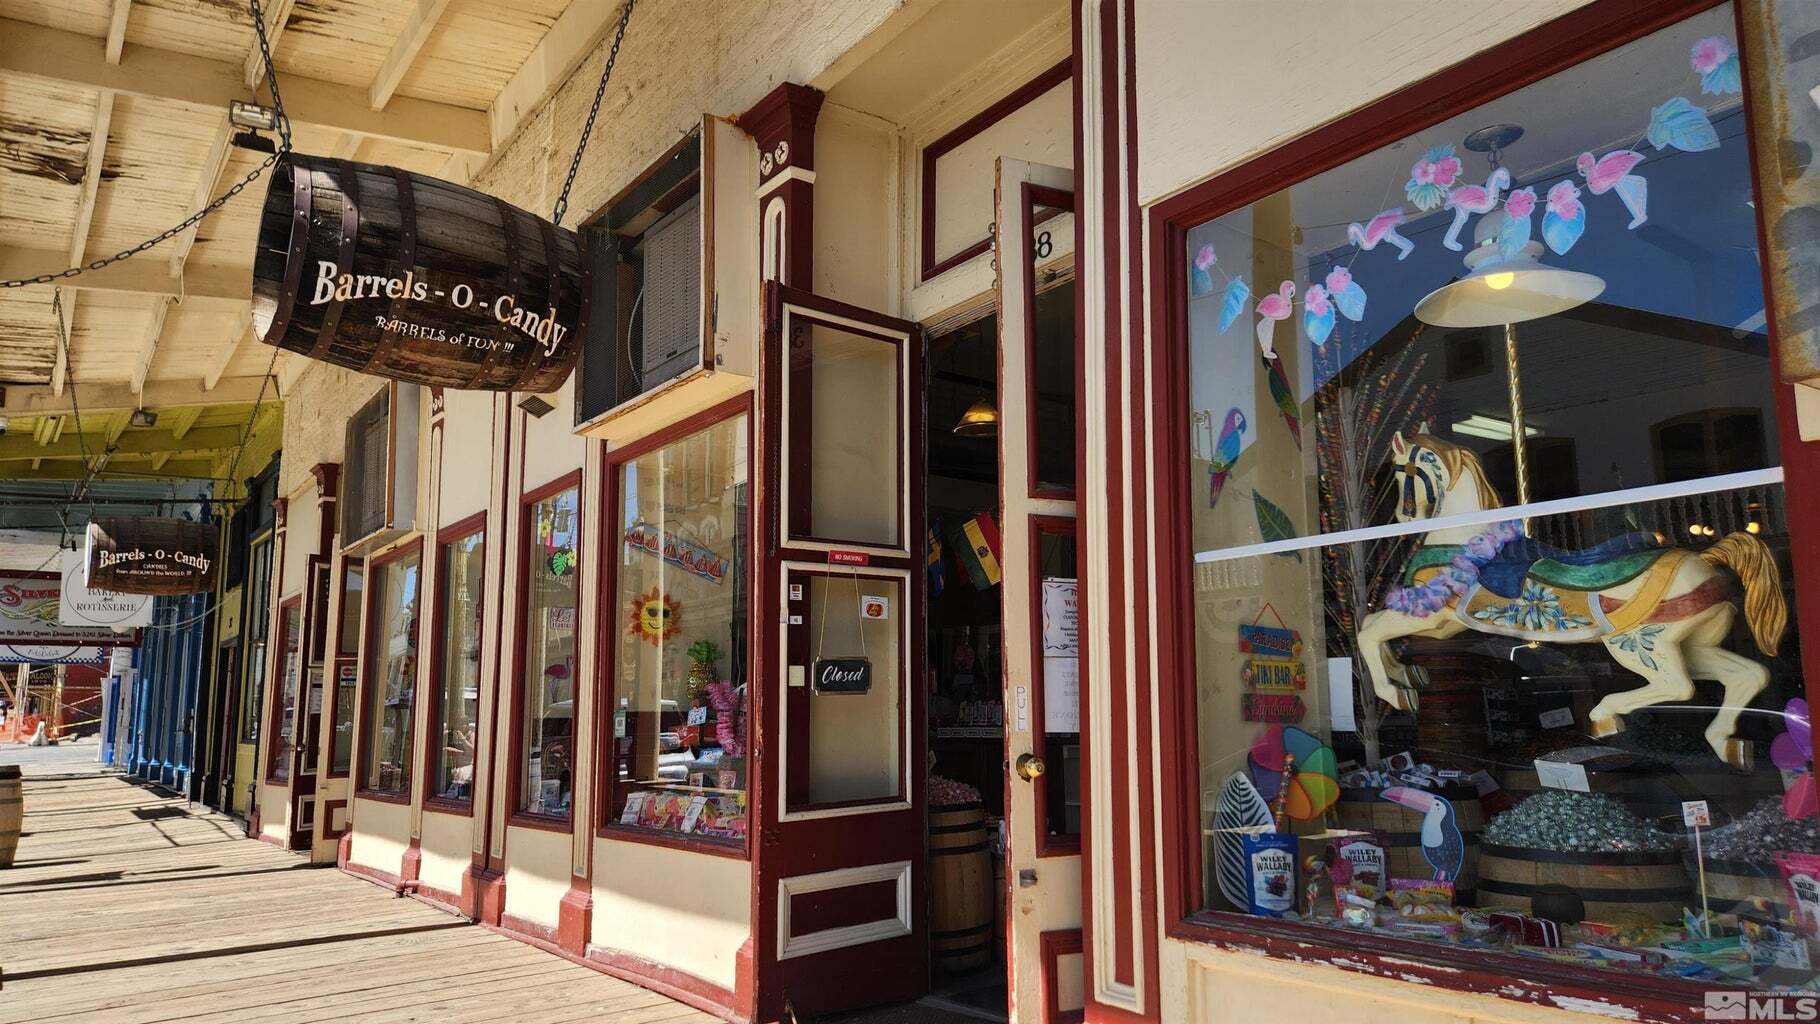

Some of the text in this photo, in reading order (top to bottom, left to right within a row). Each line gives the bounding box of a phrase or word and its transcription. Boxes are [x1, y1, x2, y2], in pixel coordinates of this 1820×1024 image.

[310, 260, 427, 305] Barrels
[451, 284, 474, 308] O
[494, 295, 567, 357] Candy
[375, 315, 446, 342] BARRELS
[450, 334, 465, 346] of
[99, 548, 145, 569] Barrels
[174, 551, 210, 575] Candy
[842, 554, 863, 562] SMOKING
[77, 602, 136, 612] ROTISSERIE
[822, 665, 864, 684] Closed
[1256, 664, 1291, 685] TIKI BAR
[1016, 686, 1026, 731] PULL
[1256, 862, 1291, 872] WALLABY
[1345, 855, 1381, 865] WALLABY
